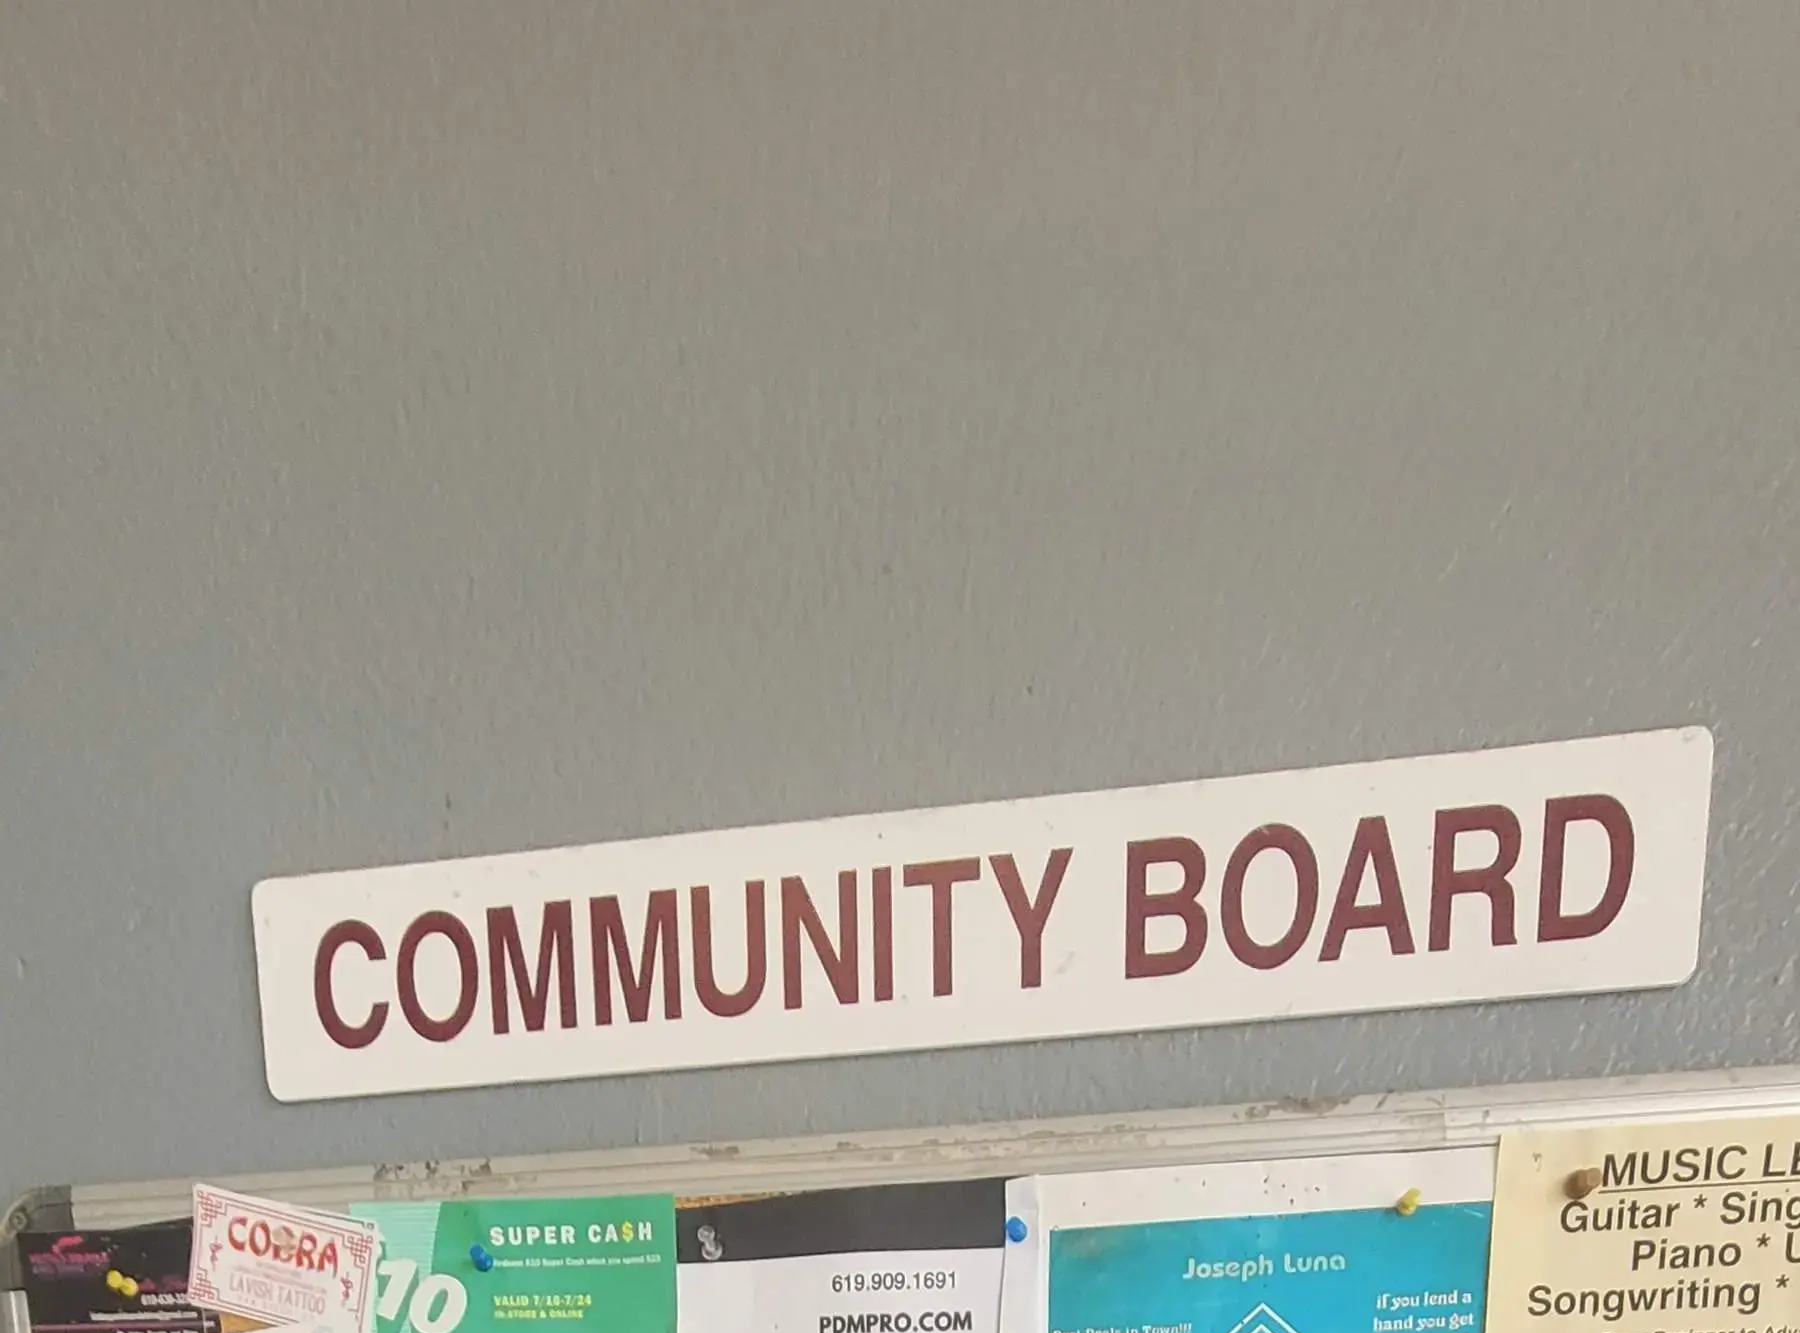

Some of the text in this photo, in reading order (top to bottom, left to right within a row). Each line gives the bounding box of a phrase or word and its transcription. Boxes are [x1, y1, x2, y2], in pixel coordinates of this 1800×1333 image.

[314, 791, 1634, 1049] COMMUNITY BOARD
[1601, 1145, 1747, 1187] MUSIC
[1560, 1200, 1680, 1233] Guitar
[490, 1221, 652, 1246] SUPER CA$H
[1182, 1252, 1346, 1282] Joseph Luna
[1631, 1239, 1741, 1271] Piano
[832, 1271, 958, 1293] 619.909.1691
[277, 1284, 325, 1315] TATTOO
[493, 1296, 528, 1307] VALID
[1390, 1290, 1472, 1311] you lend a
[1528, 1279, 1761, 1321] Songwriting
[1373, 1313, 1474, 1331] hand you get
